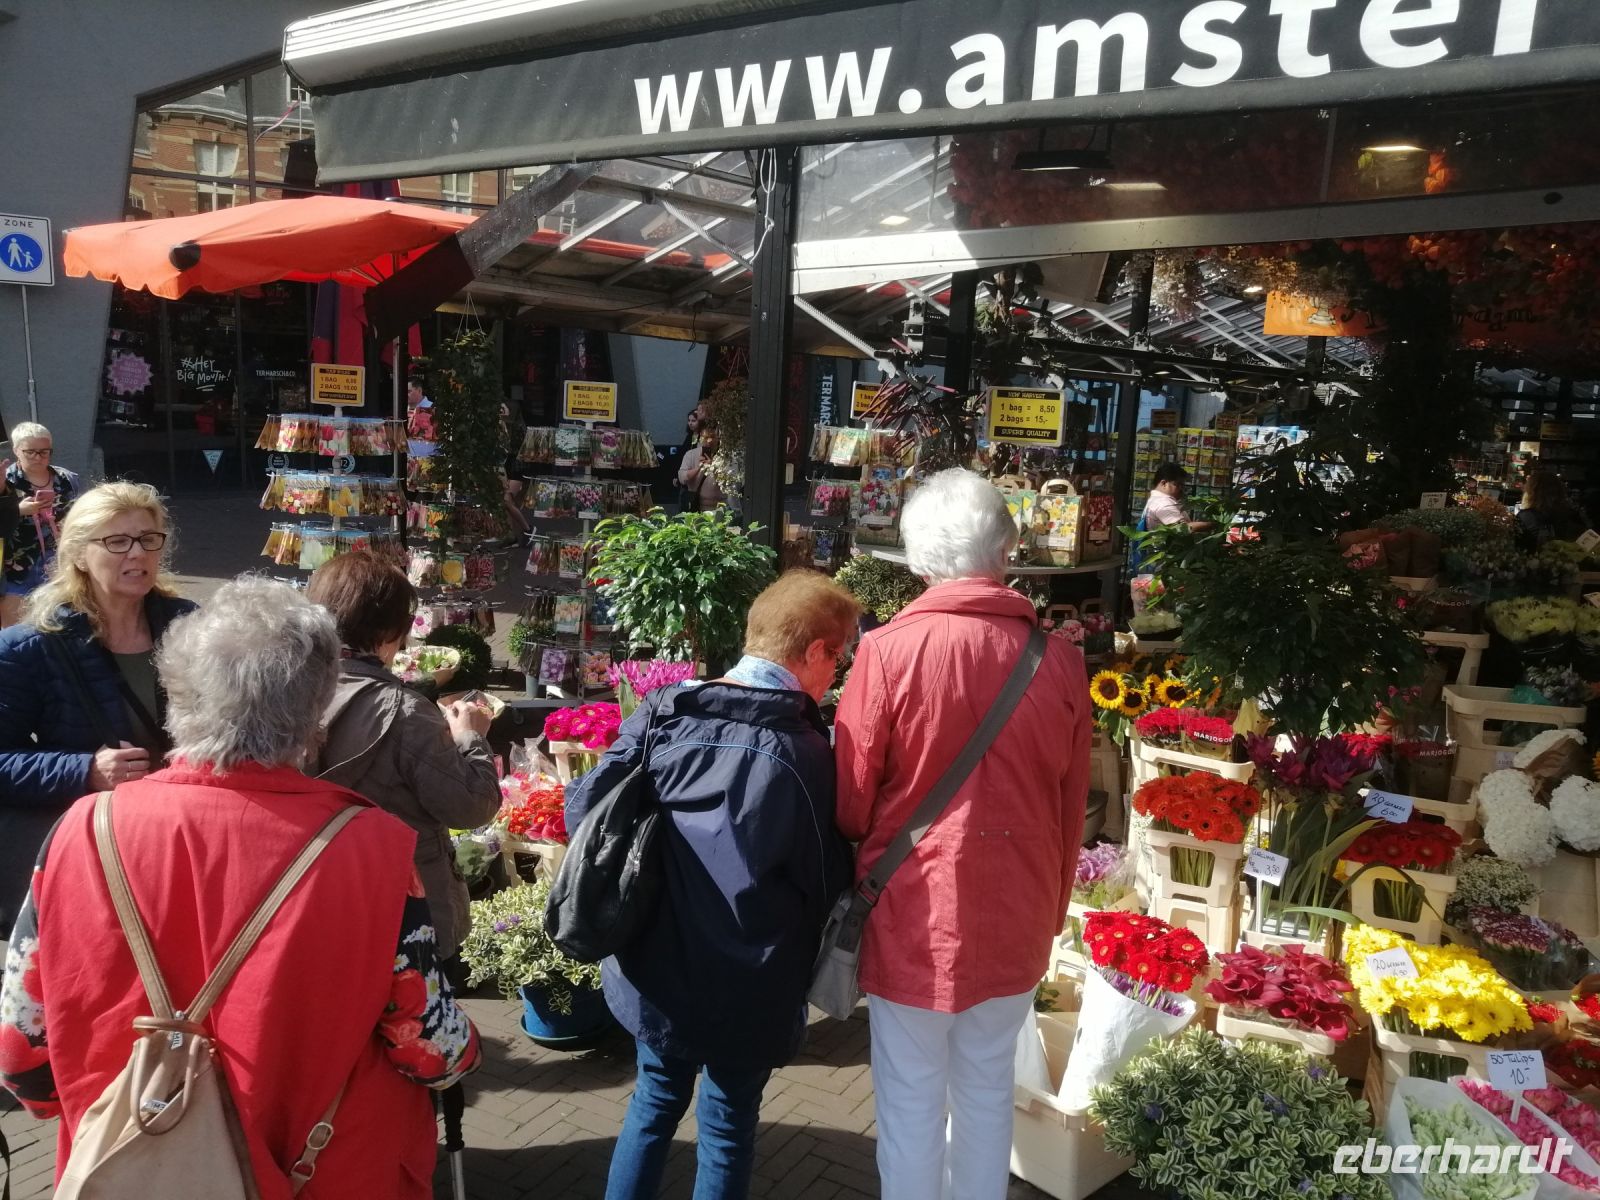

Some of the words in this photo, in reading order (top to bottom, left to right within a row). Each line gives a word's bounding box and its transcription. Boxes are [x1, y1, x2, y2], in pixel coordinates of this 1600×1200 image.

[4, 219, 33, 228] ZONE
[1009, 403, 1022, 413] bag
[1040, 405, 1056, 414] 8,50
[1006, 414, 1024, 424] bags
[1026, 430, 1051, 438] QUALITY
[1372, 792, 1385, 803] 20
[1373, 958, 1386, 970] 20
[1490, 1054, 1504, 1064] 50
